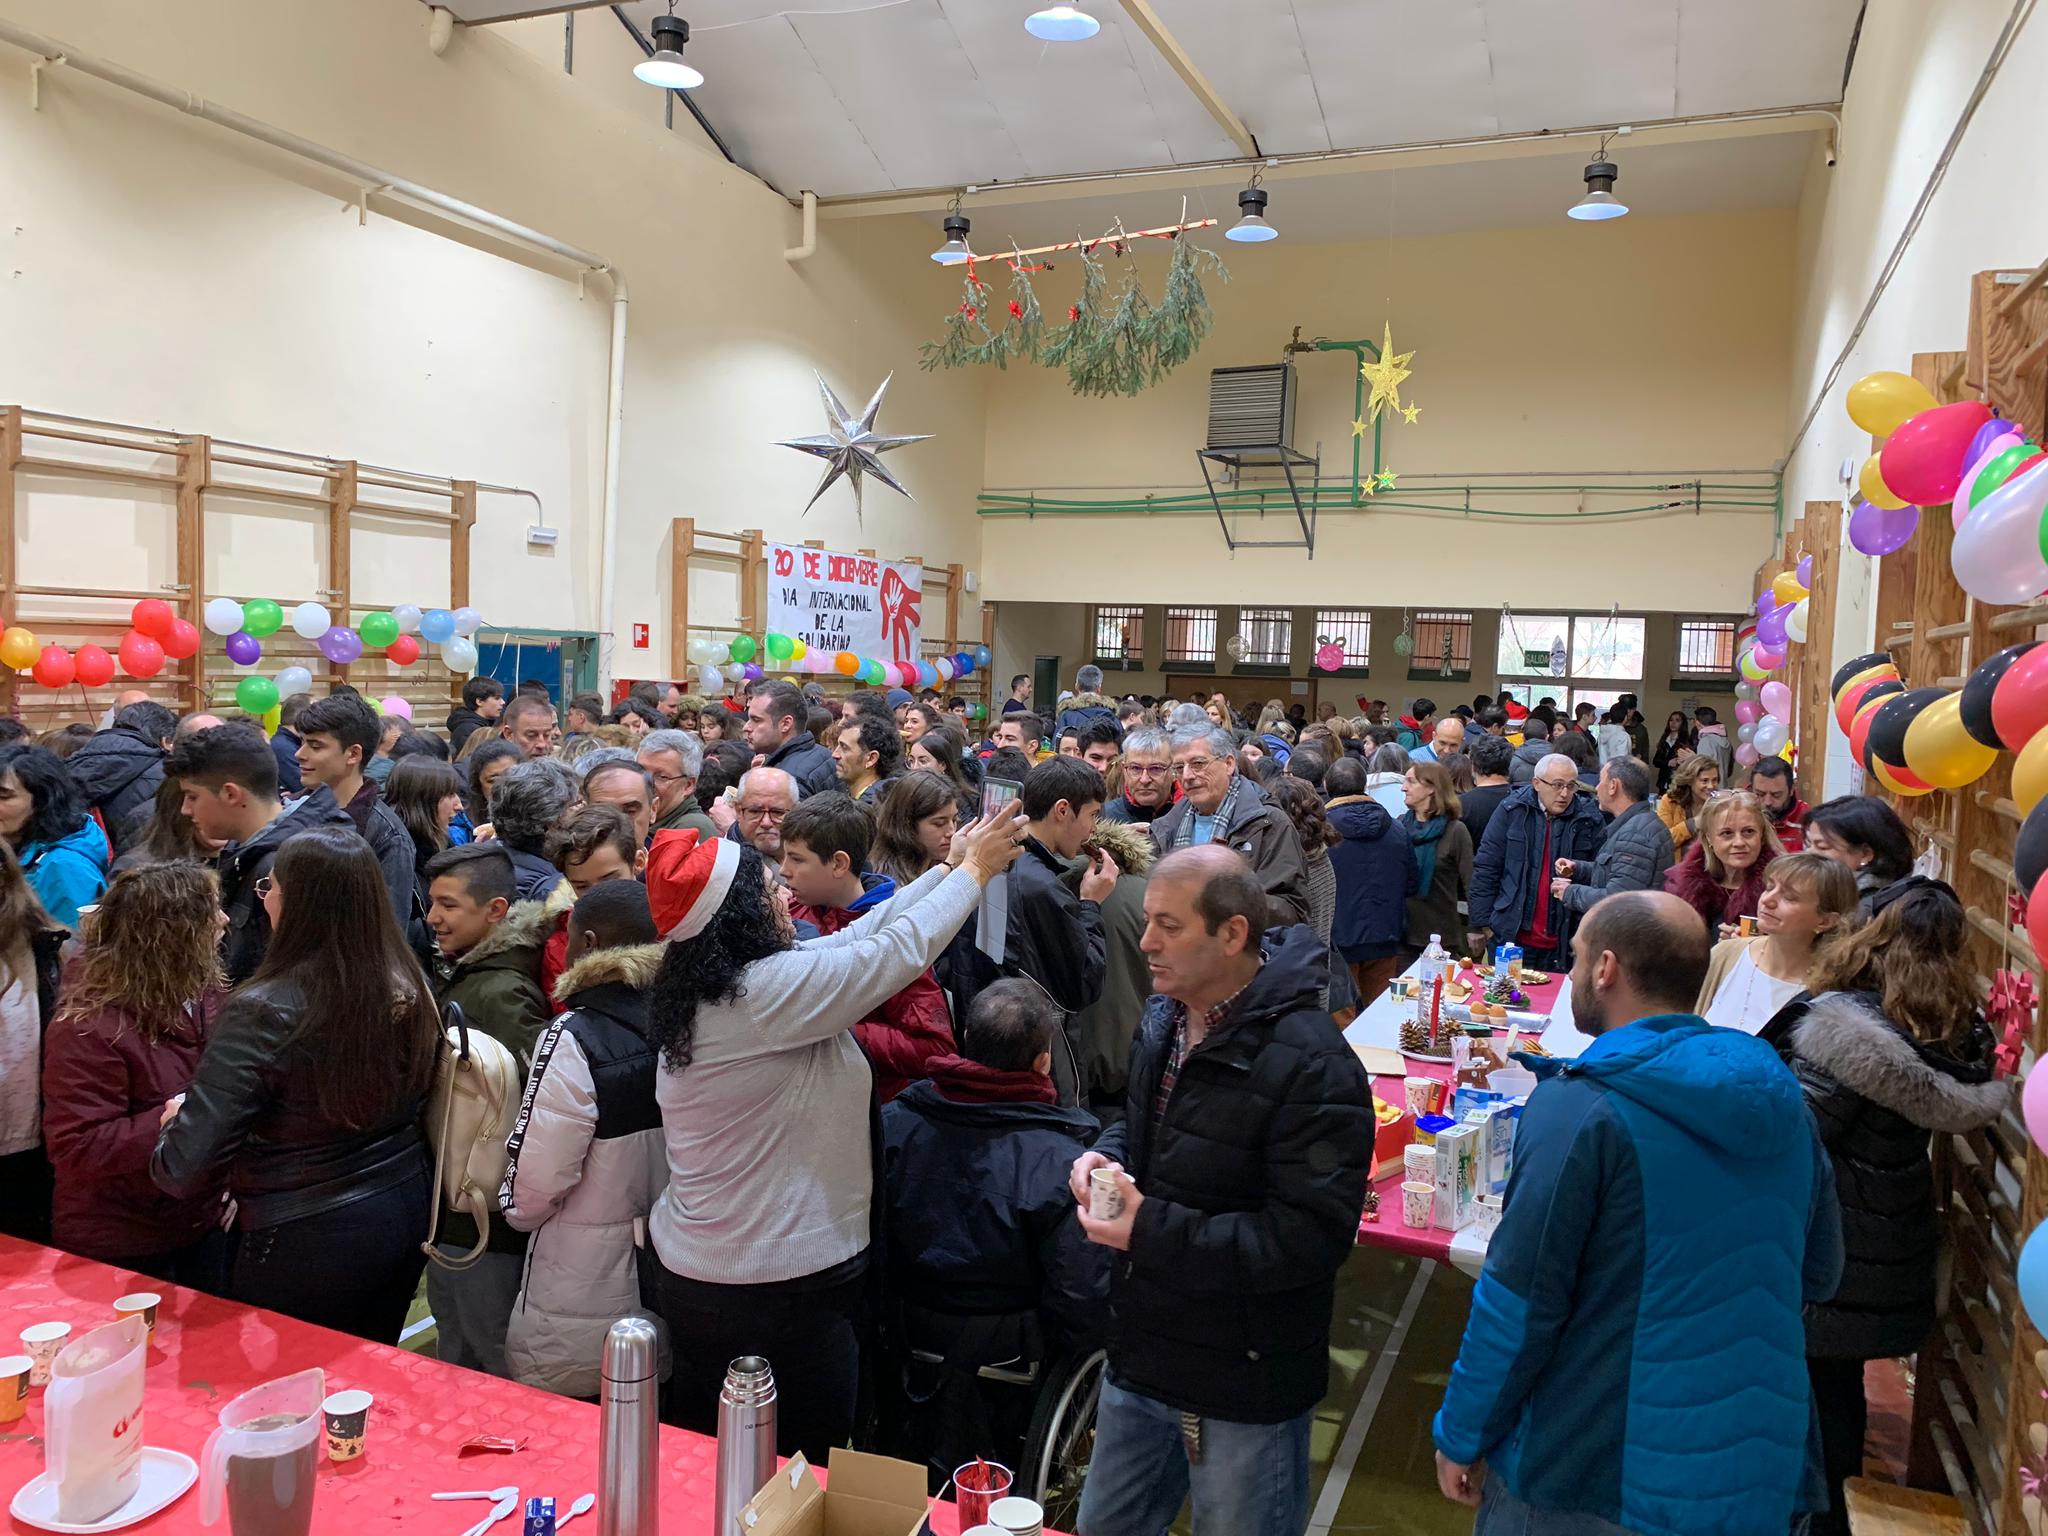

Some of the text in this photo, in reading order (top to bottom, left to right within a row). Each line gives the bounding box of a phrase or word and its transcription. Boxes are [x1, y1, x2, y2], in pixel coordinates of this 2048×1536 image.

[774, 548, 878, 587] 20 DE DICIEMBRE
[809, 591, 872, 612] INTERNACIONAL
[815, 613, 844, 632] DE LA
[540, 1010, 575, 1056] WILD SPIRIT
[514, 1077, 539, 1135] WILD SPIRIT
